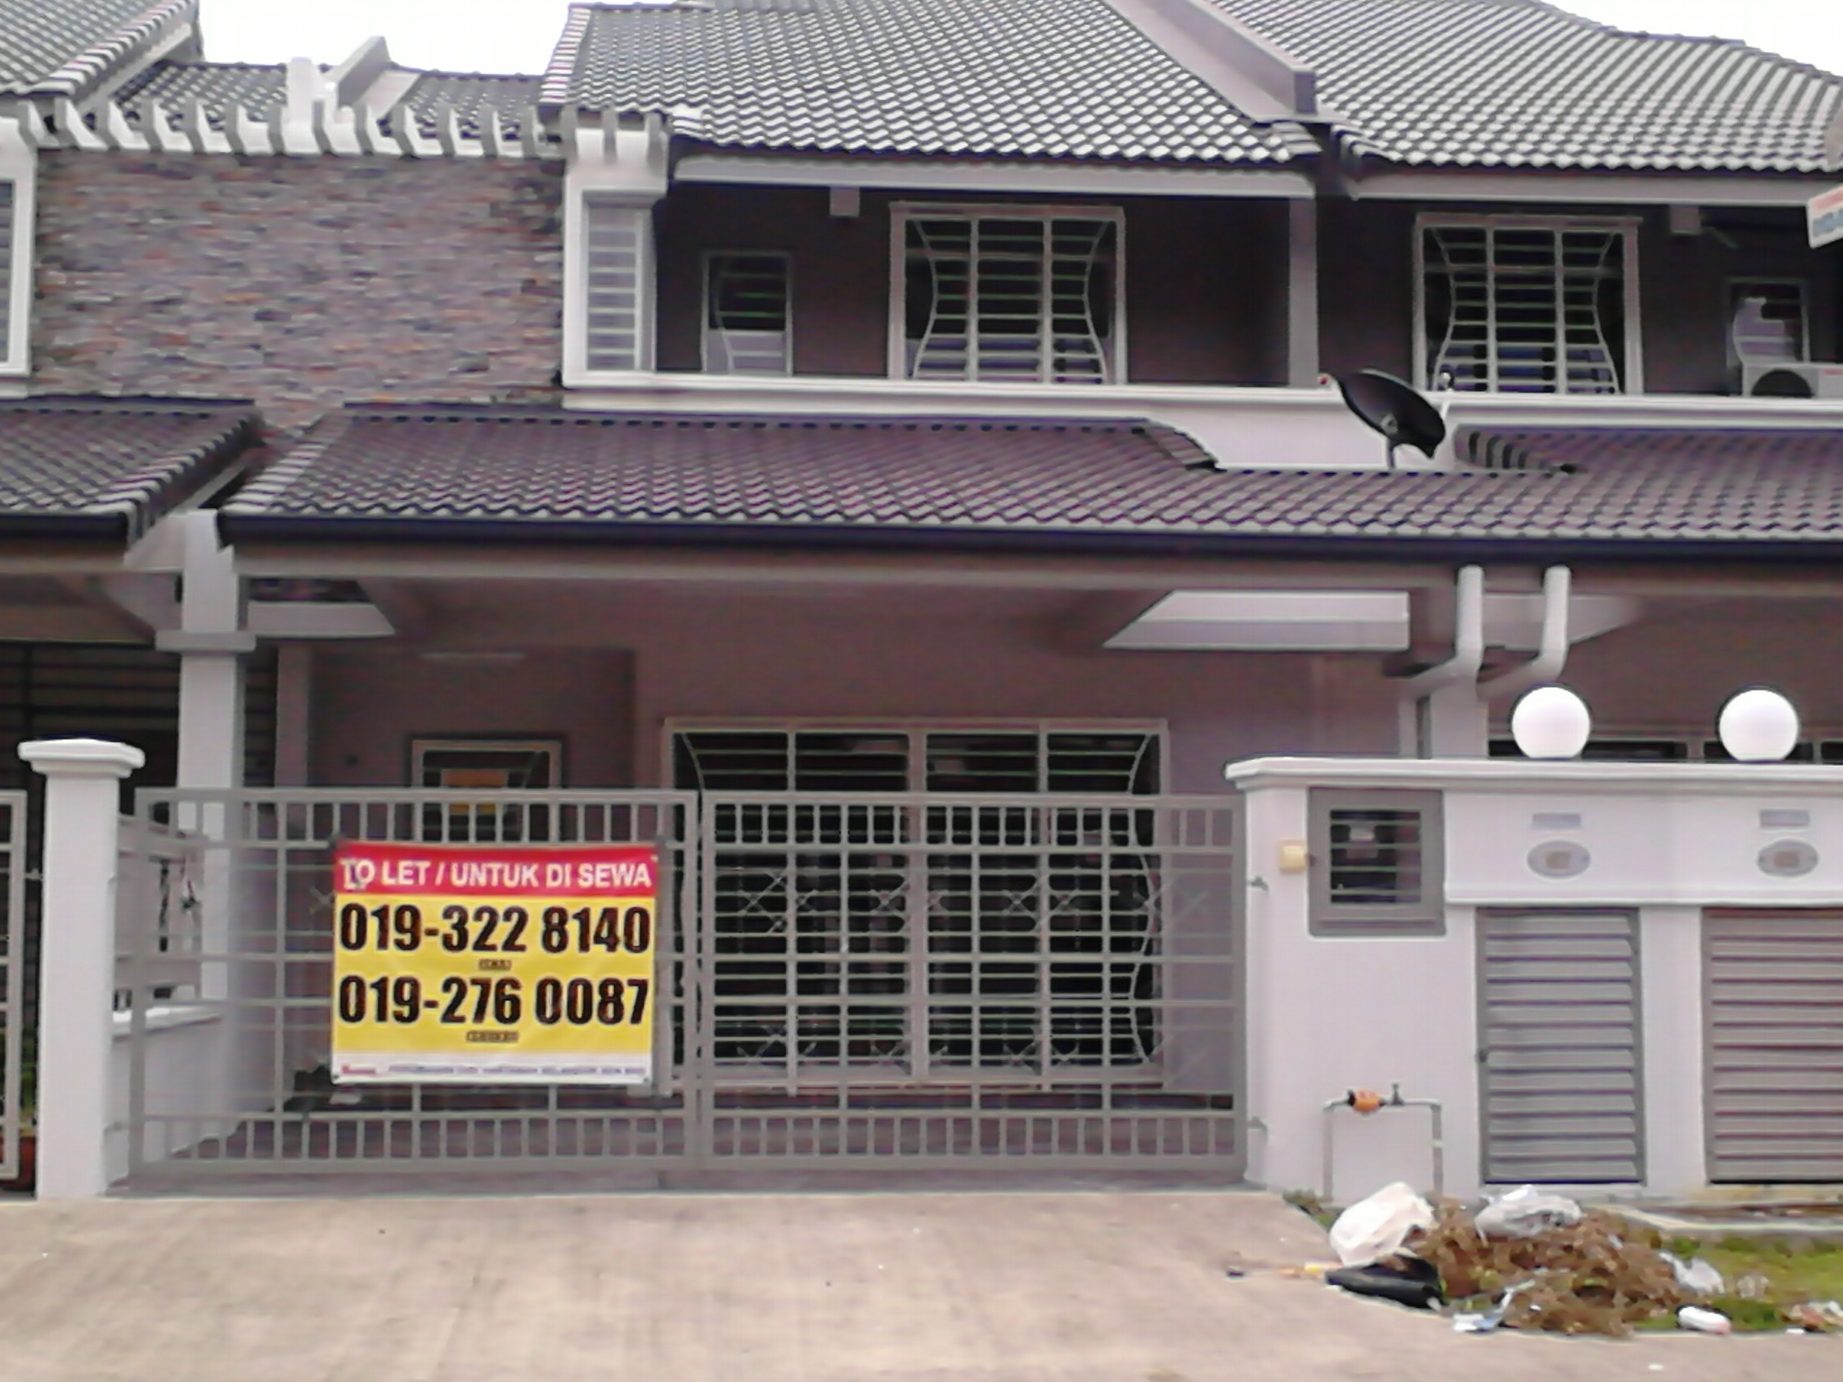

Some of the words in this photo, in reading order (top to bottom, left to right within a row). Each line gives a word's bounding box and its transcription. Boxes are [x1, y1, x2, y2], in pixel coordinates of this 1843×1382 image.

[340, 858, 376, 890] TO
[381, 860, 431, 886] LET
[435, 862, 445, 886] /
[450, 861, 539, 888] UNTUK
[546, 863, 571, 888] DI
[577, 863, 652, 889] SEWA
[340, 903, 529, 952] 019-322
[541, 906, 650, 953] 8140
[339, 975, 522, 1025] 019-276
[534, 977, 649, 1026] 0087
